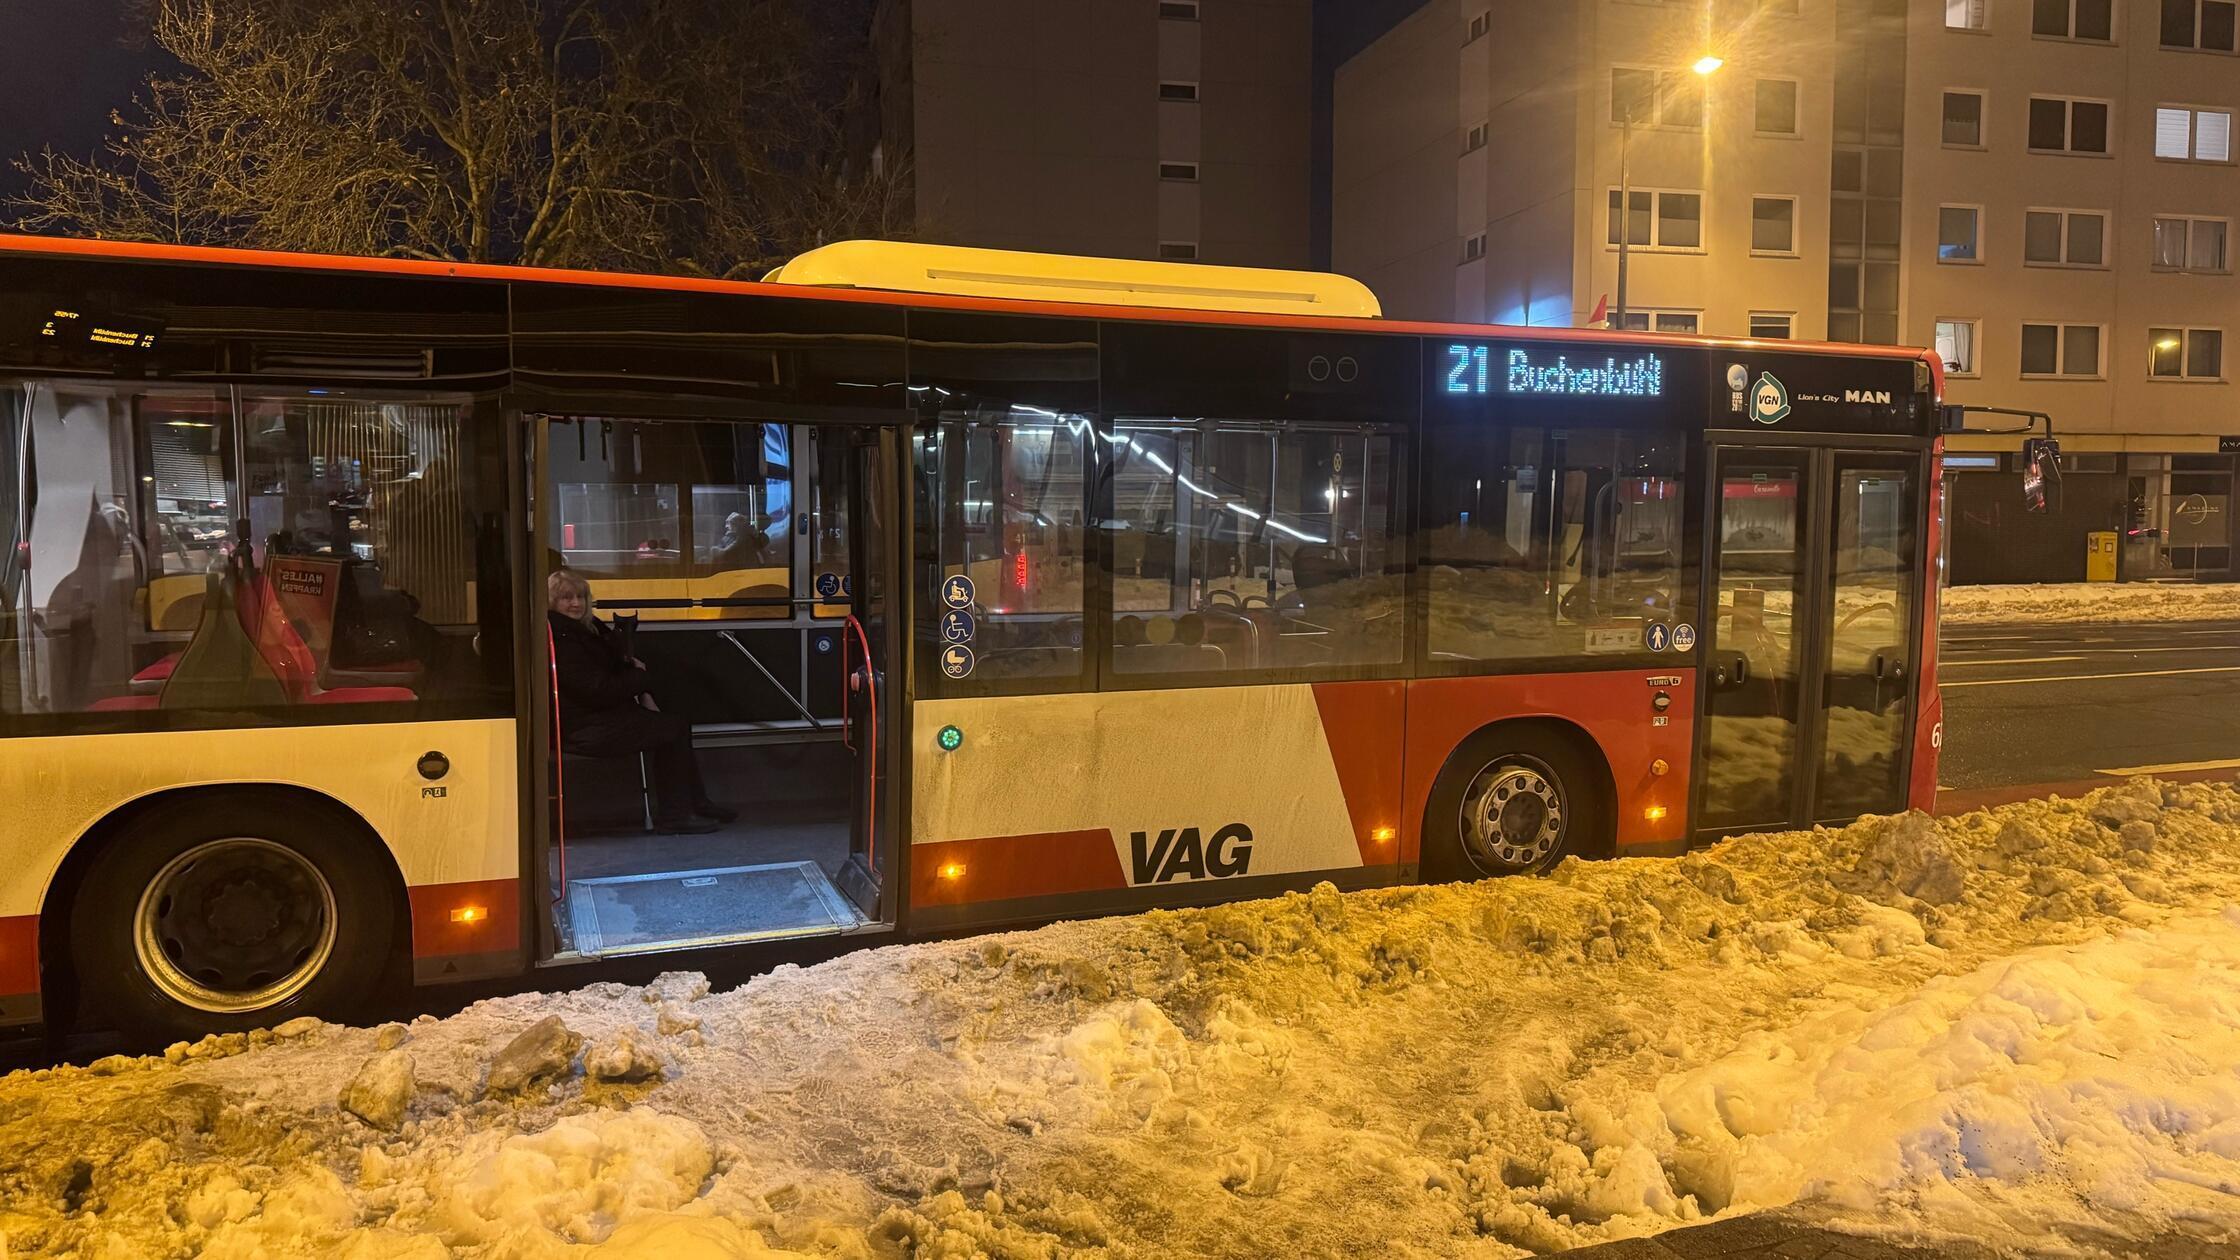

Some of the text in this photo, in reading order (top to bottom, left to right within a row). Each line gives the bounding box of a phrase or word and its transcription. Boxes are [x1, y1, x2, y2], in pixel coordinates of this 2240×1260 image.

[1448, 345, 1488, 392] 21
[1758, 394, 1780, 405] VGN
[1797, 393, 1840, 404] Lion's City
[1845, 390, 1891, 404] MAN
[1675, 635, 1693, 645] free
[1129, 822, 1253, 884] VAG
